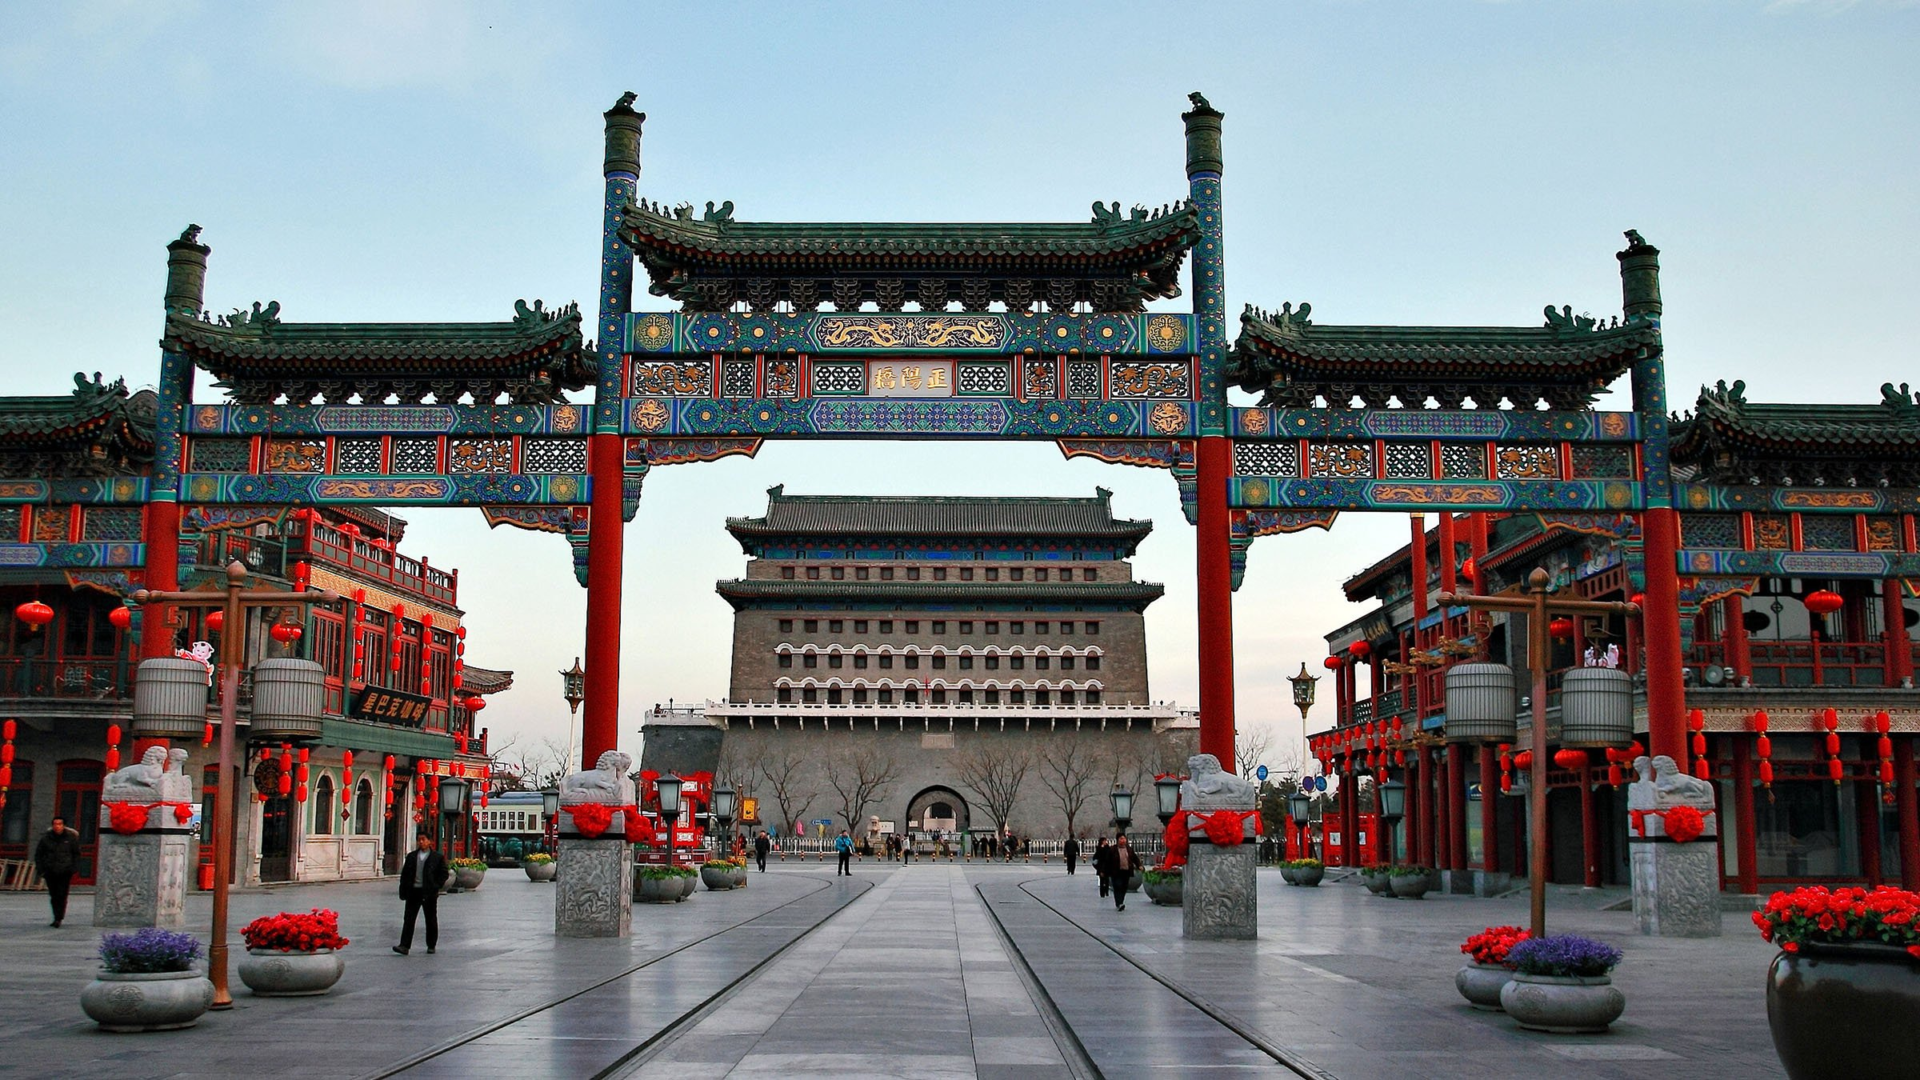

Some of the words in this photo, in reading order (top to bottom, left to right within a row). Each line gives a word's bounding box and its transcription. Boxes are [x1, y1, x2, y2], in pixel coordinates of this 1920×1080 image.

[361, 692, 426, 721] 星巴克咖啡
